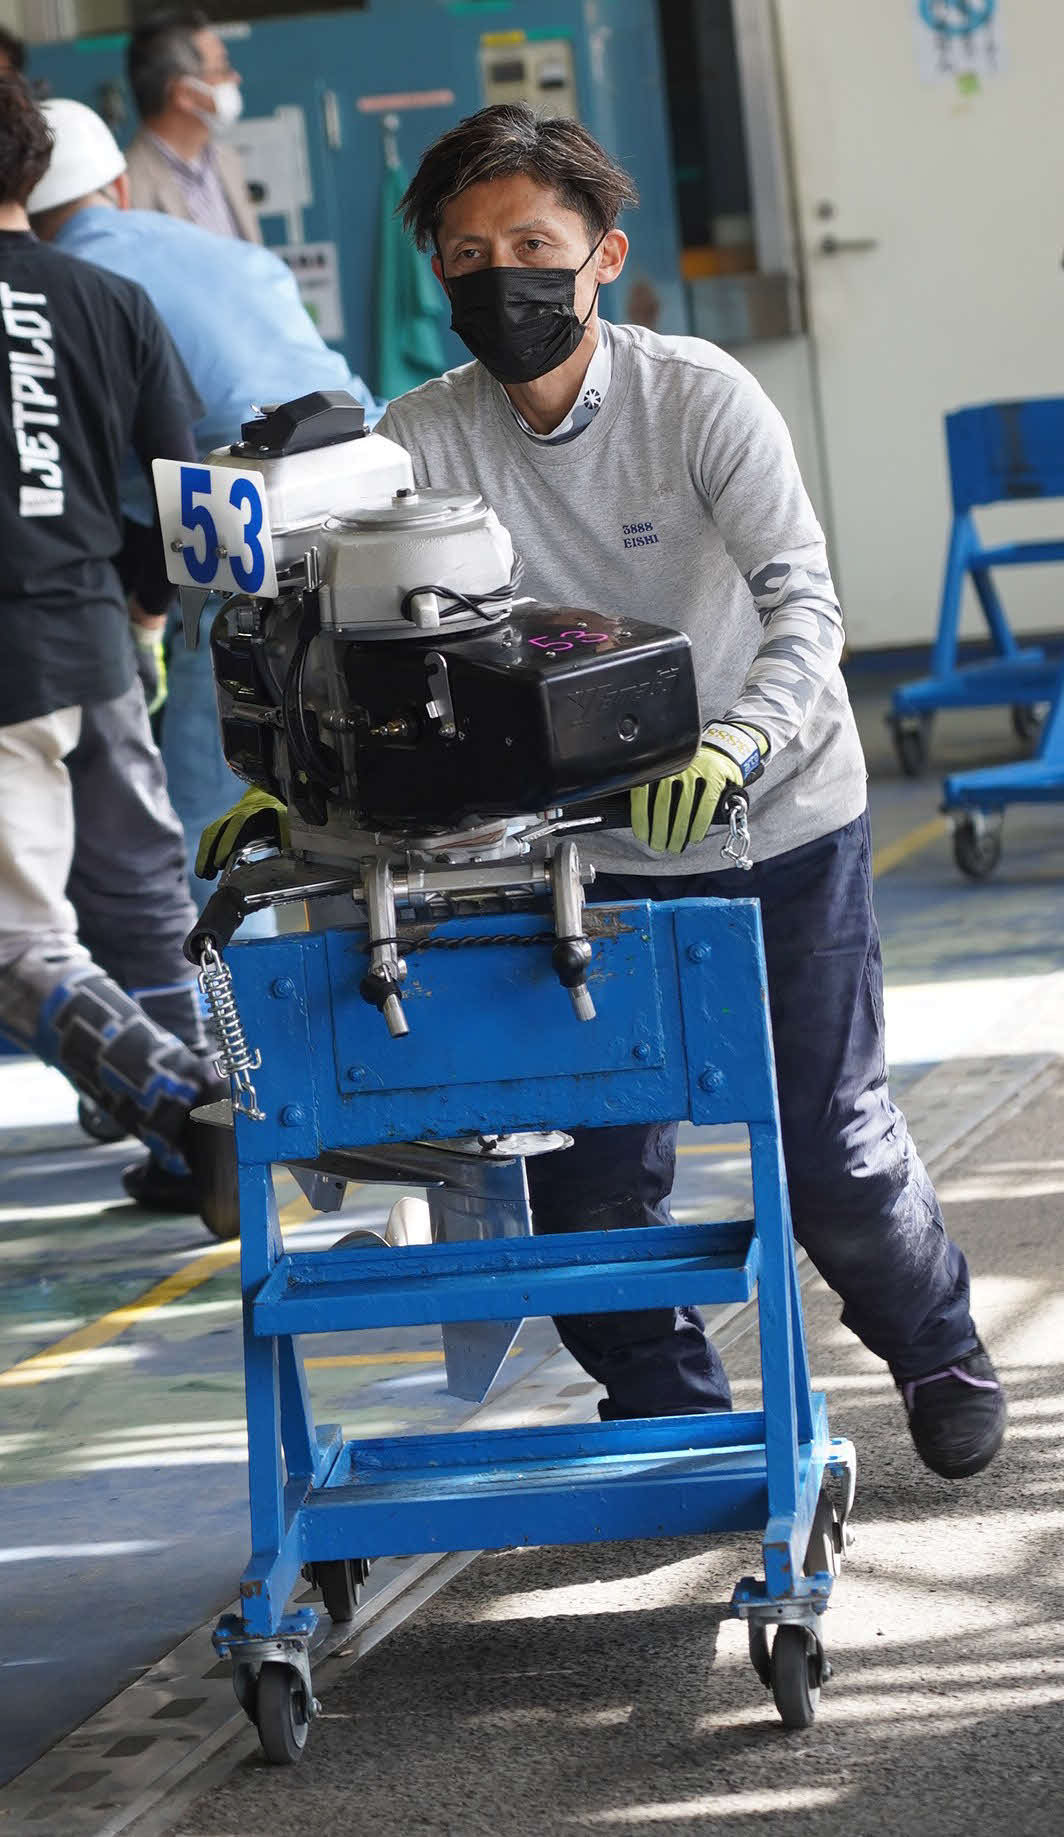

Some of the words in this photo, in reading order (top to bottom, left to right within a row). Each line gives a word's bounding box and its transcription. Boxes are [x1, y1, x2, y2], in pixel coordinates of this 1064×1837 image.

[0, 281, 63, 488] JETPILOT
[180, 466, 265, 594] 53
[622, 521, 654, 535] 3888
[623, 534, 660, 549] EISHI
[528, 630, 609, 651] 53
